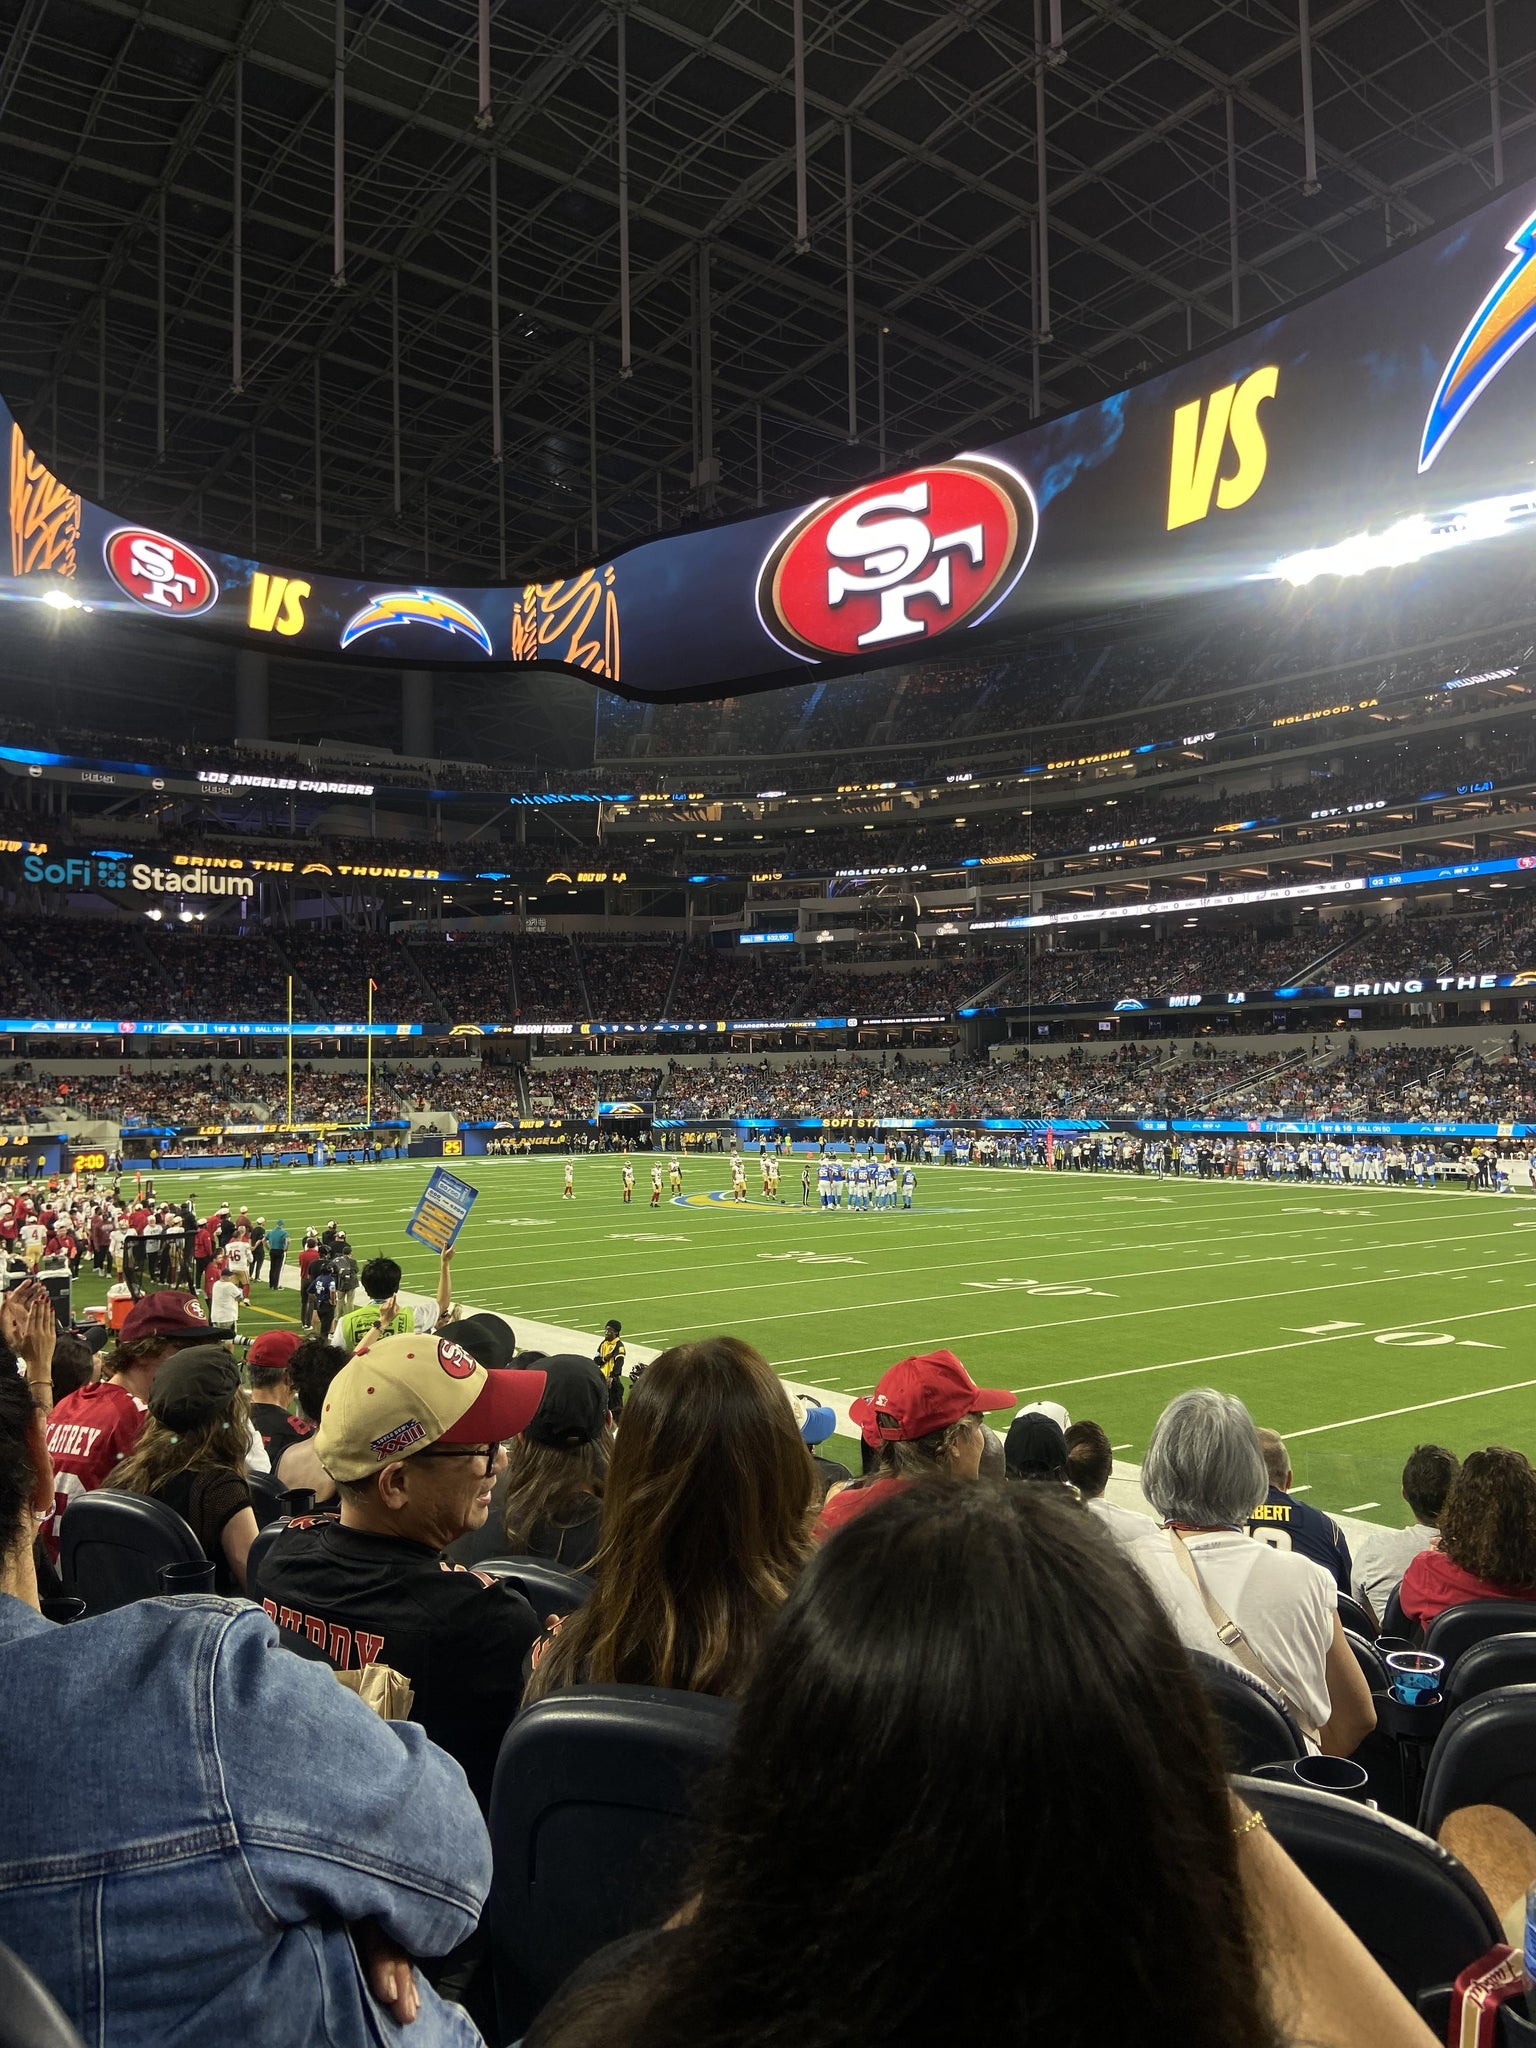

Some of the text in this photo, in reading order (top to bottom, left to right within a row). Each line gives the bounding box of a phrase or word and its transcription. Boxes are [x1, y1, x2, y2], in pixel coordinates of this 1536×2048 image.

[1166, 365, 1279, 530] VS
[129, 539, 196, 607] SF
[825, 481, 986, 648] SF
[248, 572, 312, 636] VS
[1078, 750, 1131, 766] STADIUM
[199, 771, 374, 796] LOS ANGELES CHARGERS
[202, 785, 233, 794] PEPSI
[1089, 841, 1120, 853] BOLT
[1139, 836, 1156, 845] UP
[24, 855, 253, 896] SoFi Stadium
[173, 855, 440, 880] BRING THE THUNDER
[970, 921, 995, 930] AROUND
[1334, 974, 1497, 998] BRING THE
[1169, 995, 1201, 1007] BOLT UP
[513, 1025, 543, 1034] SEASON
[543, 1025, 573, 1034] TICKETS
[199, 1126, 224, 1135] LOS
[224, 1125, 278, 1135] ANGELES
[519, 1120, 534, 1129] BOLT
[534, 1119, 544, 1128] UP
[822, 1119, 853, 1128] SOFI
[444, 1142, 460, 1154] 25
[75, 1154, 105, 1170] 2:00
[30, 1228, 40, 1242] 4
[227, 1248, 242, 1263] 46
[959, 1277, 1094, 1298] 20
[1280, 1319, 1458, 1348] 10
[440, 1339, 476, 1372] SF
[374, 1420, 428, 1462] XXIII
